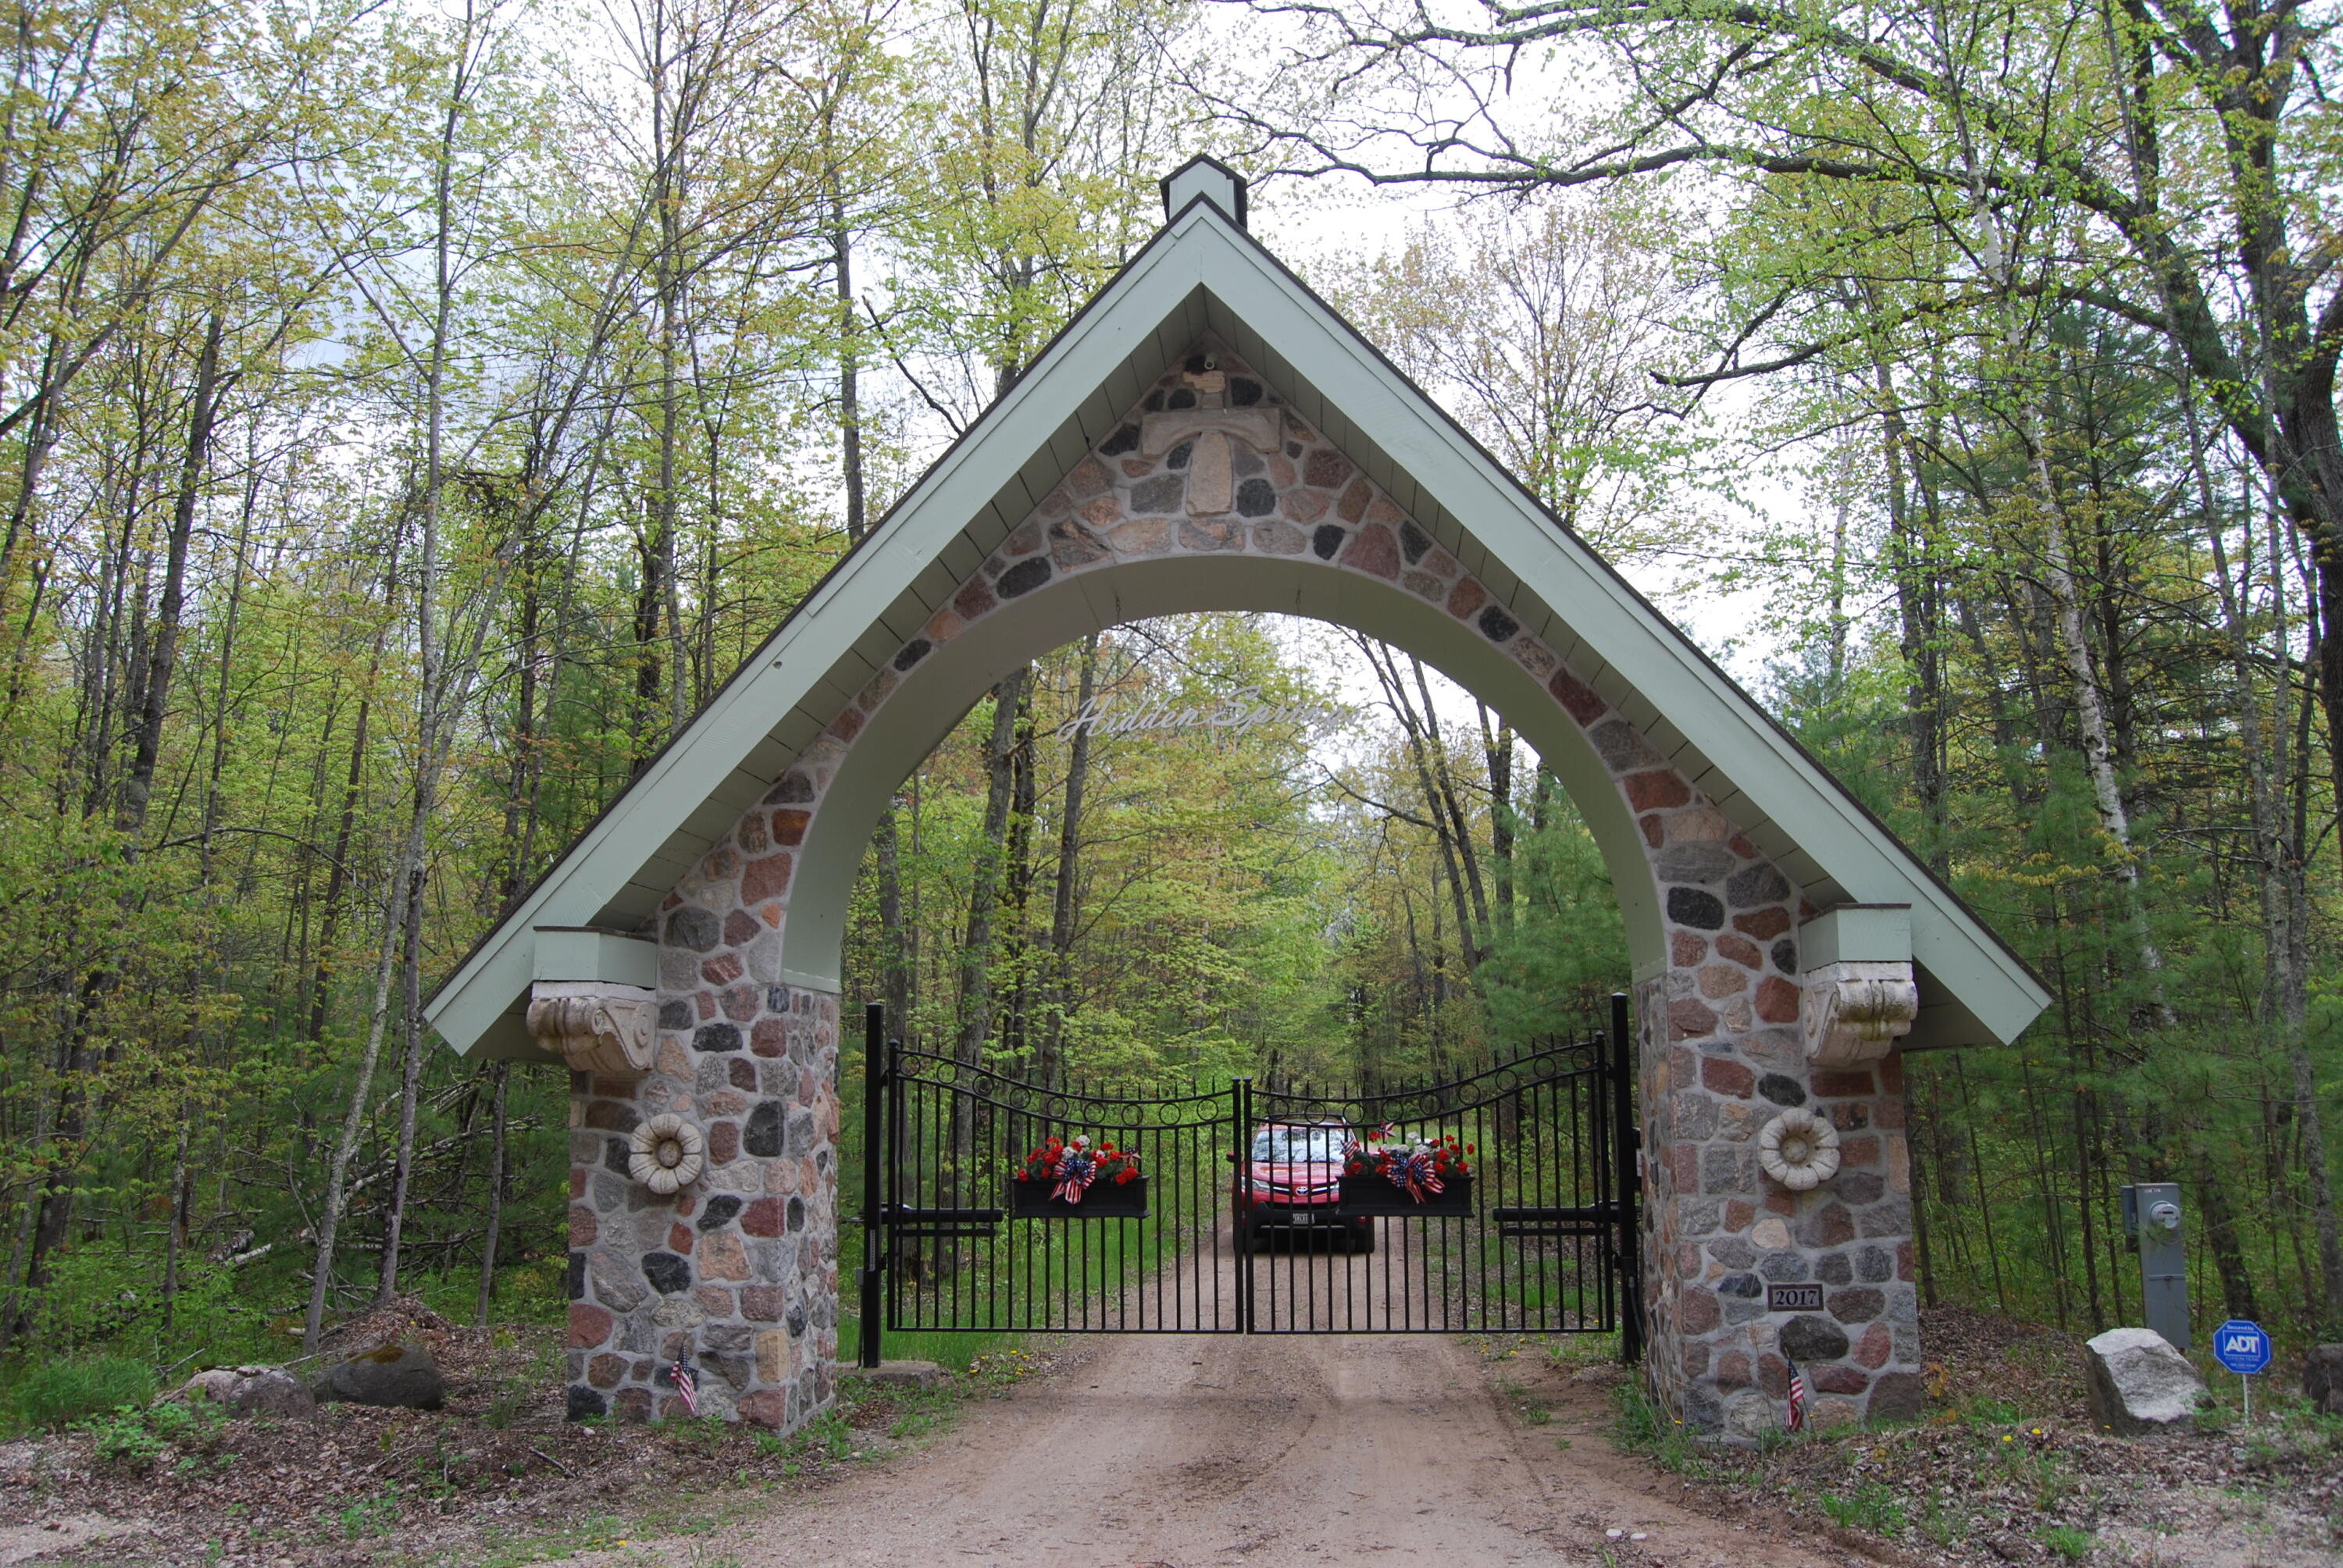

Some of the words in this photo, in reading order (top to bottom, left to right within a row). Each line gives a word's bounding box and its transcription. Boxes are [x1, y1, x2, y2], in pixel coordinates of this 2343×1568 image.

[1056, 694, 1207, 742] Hidden
[1775, 1290, 1817, 1306] 2017
[2225, 1335, 2259, 1352] ADT
